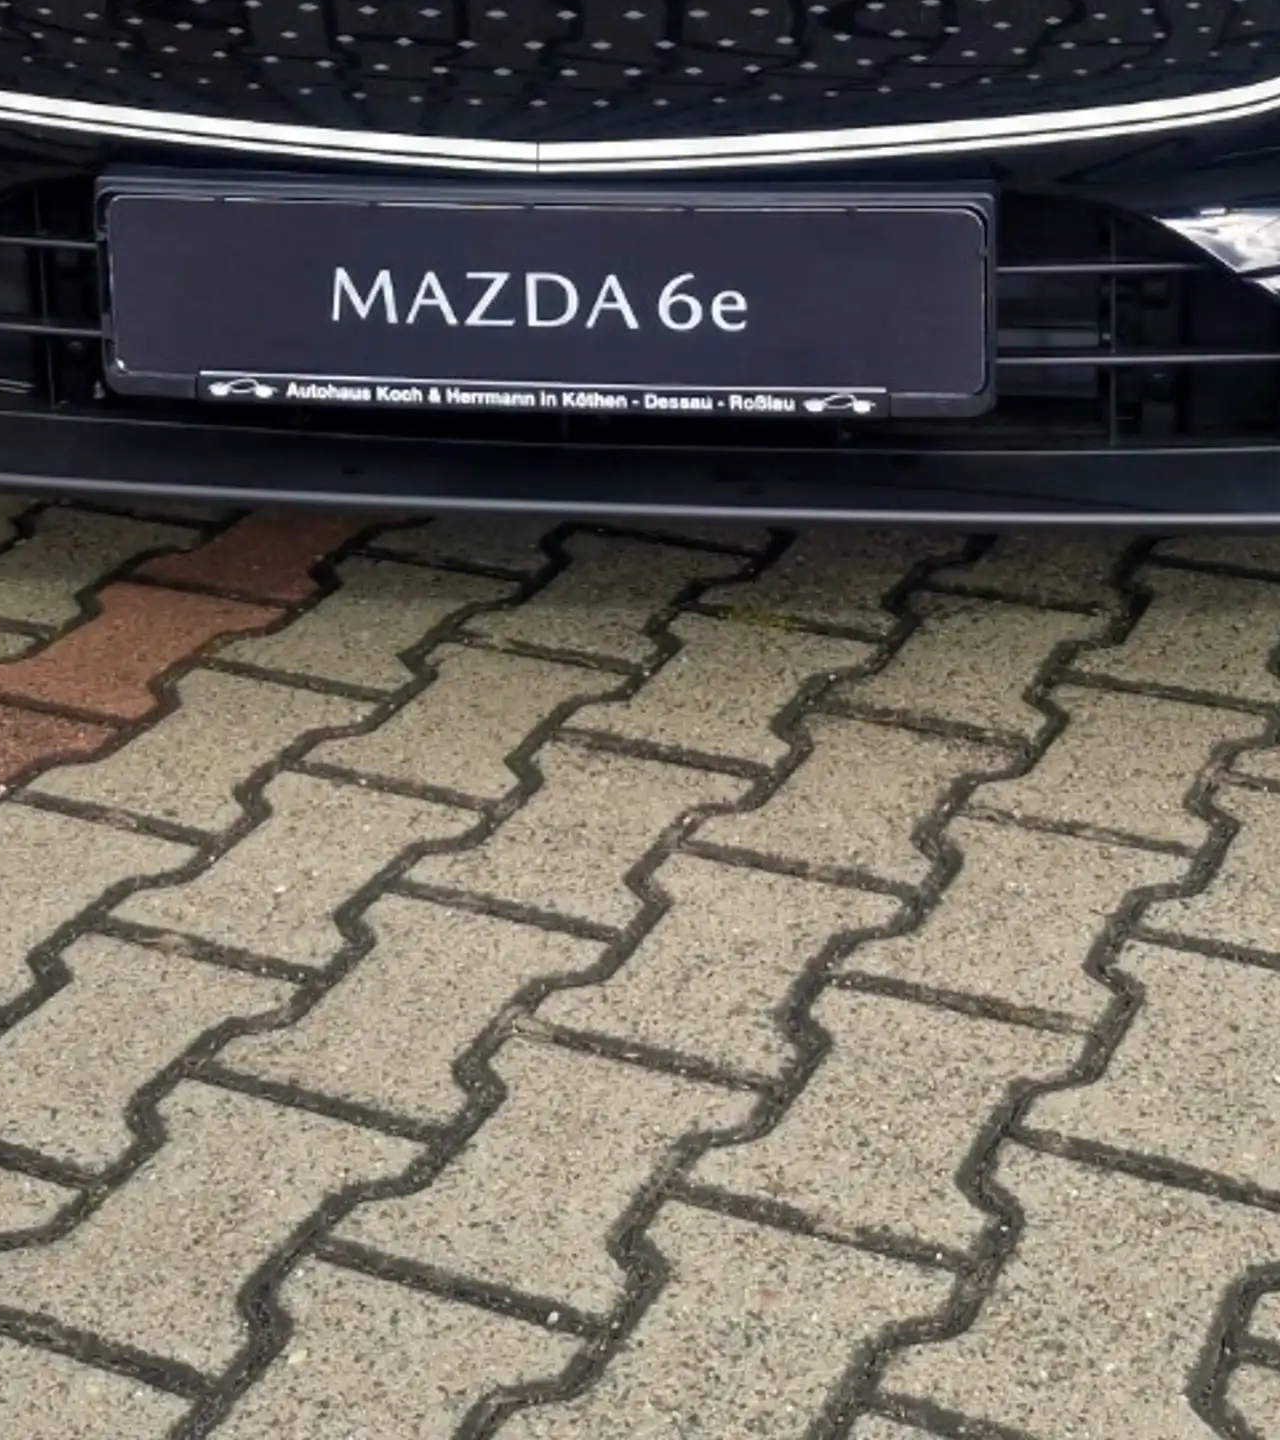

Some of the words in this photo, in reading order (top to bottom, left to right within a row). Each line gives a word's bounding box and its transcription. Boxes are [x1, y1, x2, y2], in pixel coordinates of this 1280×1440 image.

[331, 266, 640, 329] MAZDA
[657, 272, 748, 331] 6e
[286, 381, 371, 400] Autohaus
[376, 386, 422, 402] Koch
[428, 386, 441, 404] &
[445, 387, 535, 406] Herrmann
[562, 391, 628, 409] Köthen
[644, 393, 713, 410] Dessau
[728, 394, 795, 412] Roßlau
